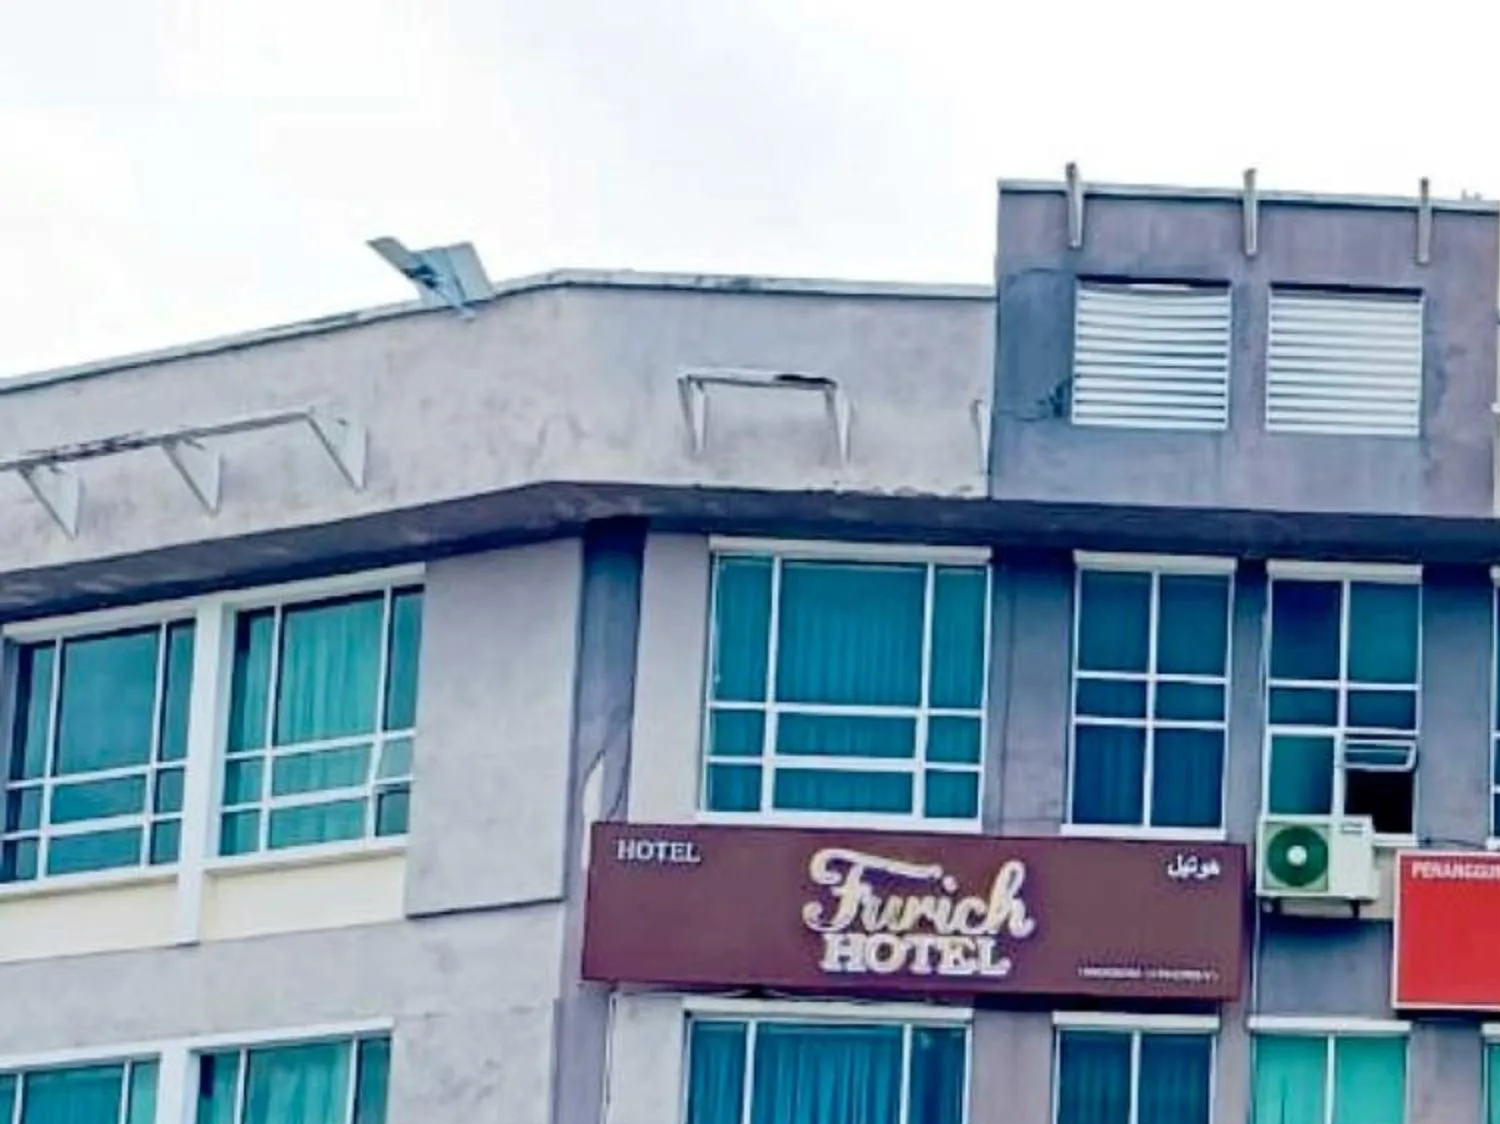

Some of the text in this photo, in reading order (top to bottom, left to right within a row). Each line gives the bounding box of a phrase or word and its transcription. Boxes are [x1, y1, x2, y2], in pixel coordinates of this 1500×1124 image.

[616, 838, 701, 863] HOTEL
[802, 848, 1035, 938] Furich
[820, 932, 1012, 977] HOTEL
